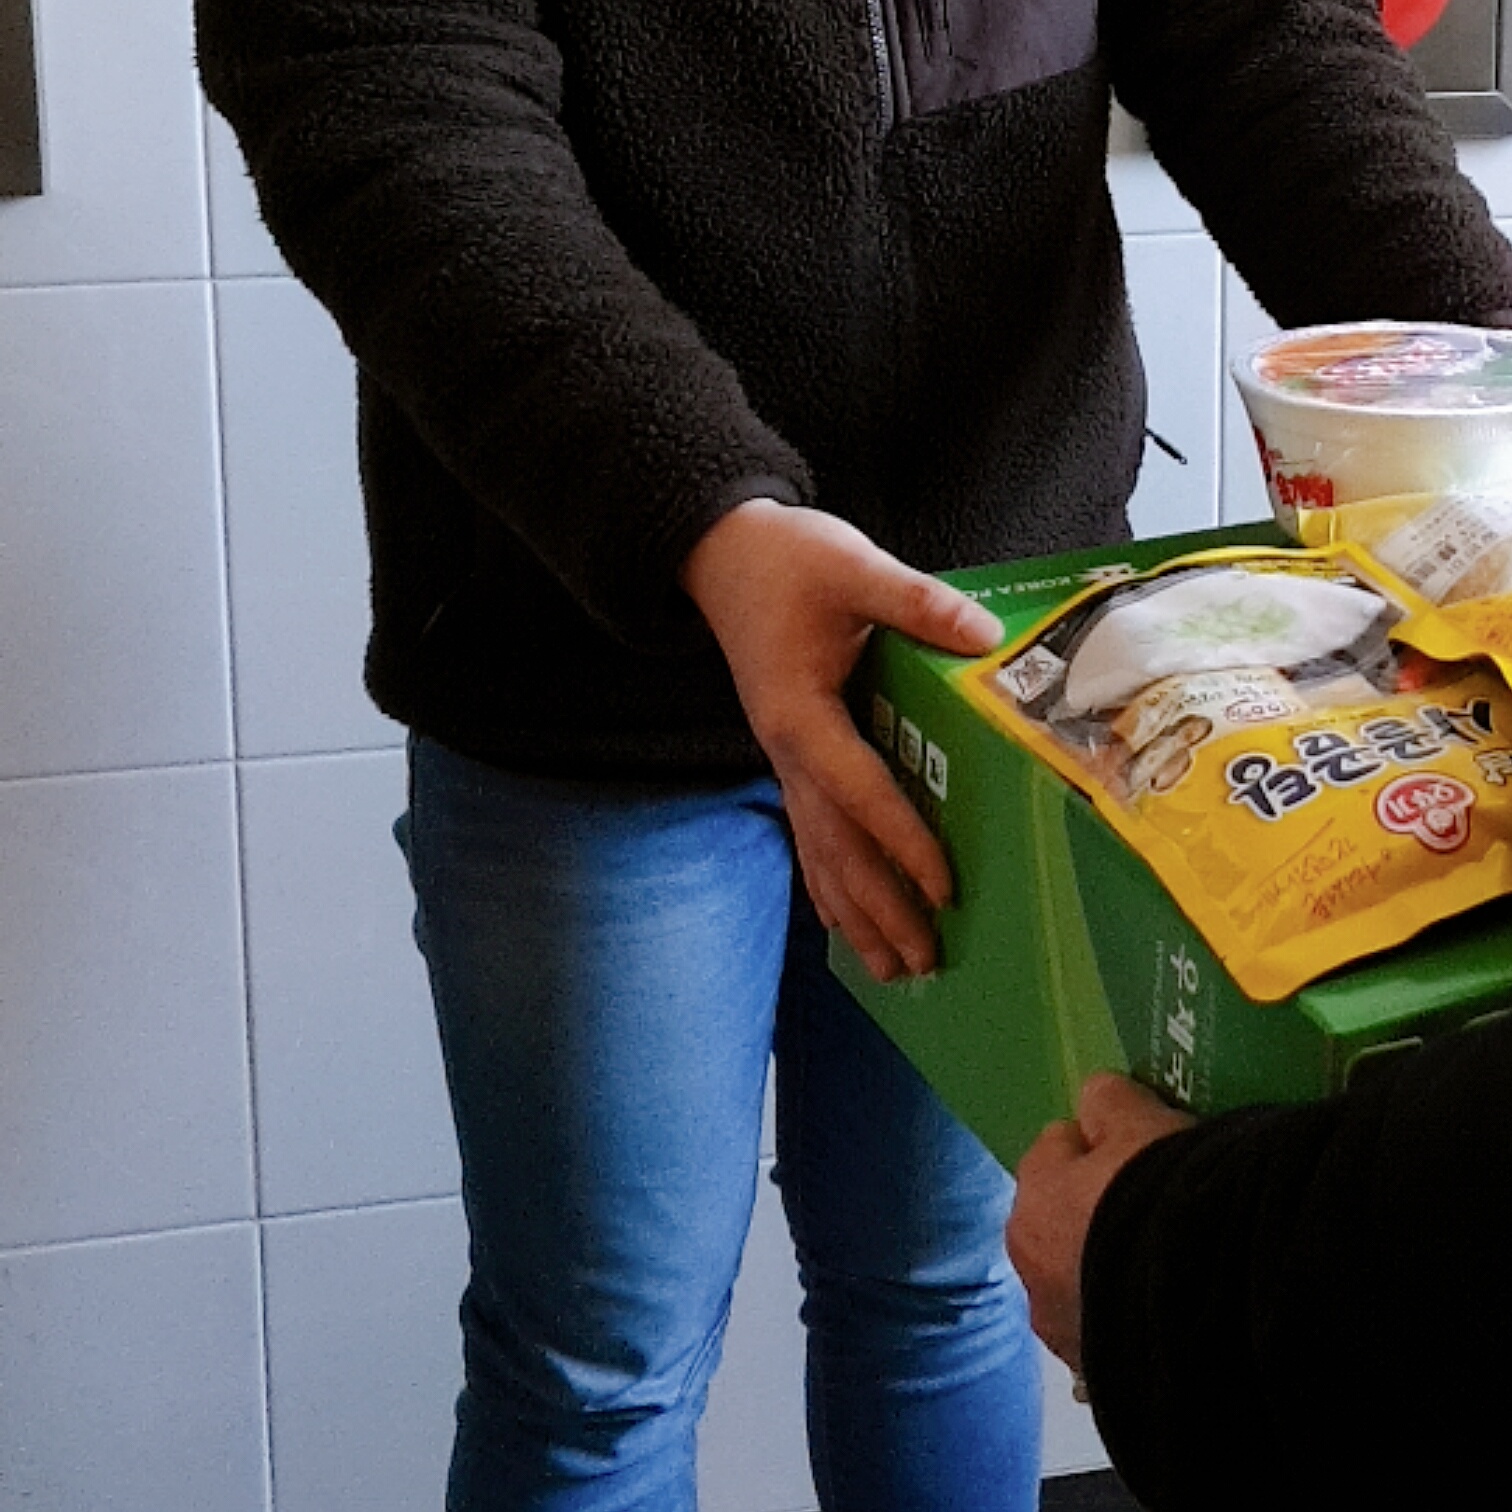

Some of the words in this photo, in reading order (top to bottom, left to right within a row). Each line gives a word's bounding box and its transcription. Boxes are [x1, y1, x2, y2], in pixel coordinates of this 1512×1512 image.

[1227, 697, 1494, 819] 사골곰탕
[1385, 780, 1458, 825] 오뚜기
[1166, 943, 1200, 1104] 우체국
